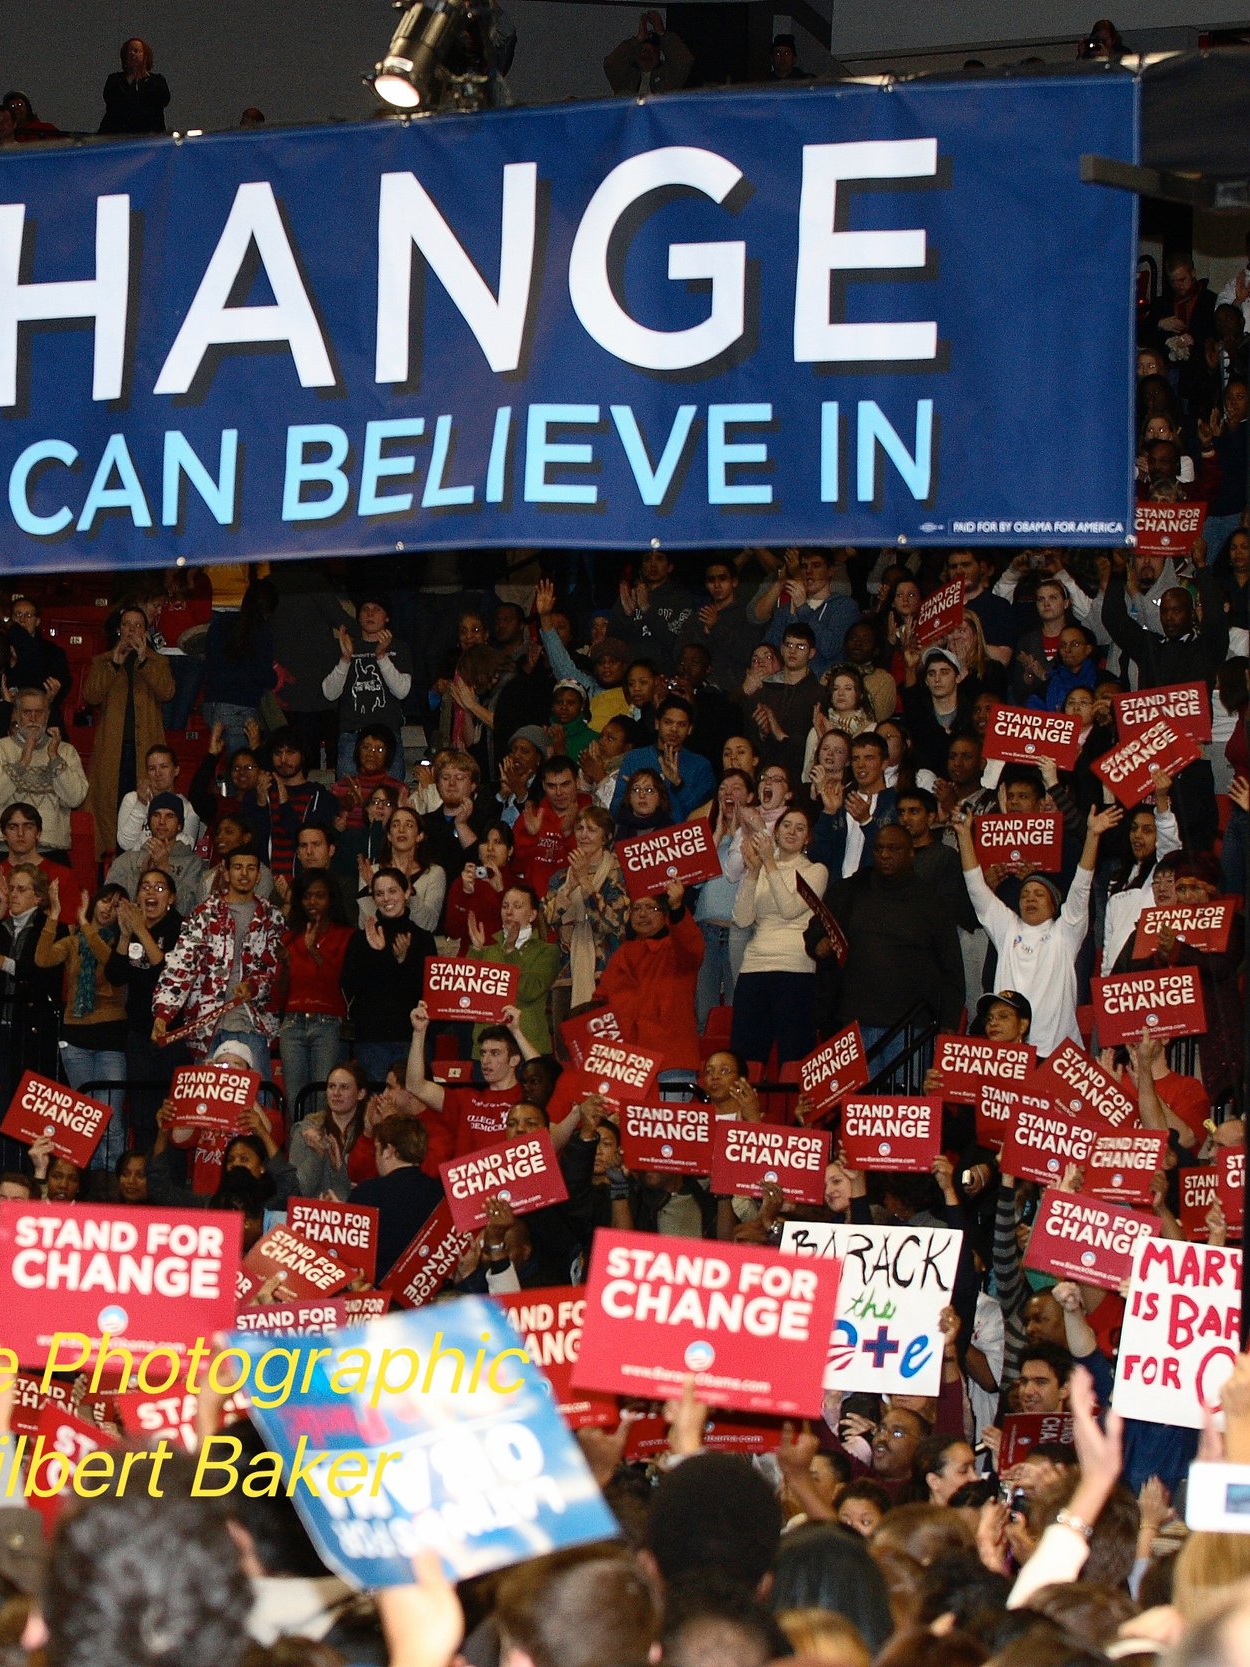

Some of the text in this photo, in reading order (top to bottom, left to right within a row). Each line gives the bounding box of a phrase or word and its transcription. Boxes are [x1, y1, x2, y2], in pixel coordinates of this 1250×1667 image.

[9, 429, 237, 535] CAN
[282, 403, 773, 522] BELIEVE
[820, 400, 934, 503] IN
[1134, 518, 1199, 532] CHANGE
[1136, 507, 1201, 519] STAND FOR
[953, 521, 1124, 533] PAID FOR BY OBAMA FOR AMERICA
[918, 590, 961, 626] CHANGE
[920, 581, 962, 614] STAND FOR
[1120, 689, 1199, 711] STAND FOR
[1121, 701, 1201, 726] CHANGE
[994, 721, 1073, 745] CHANGE
[996, 711, 1074, 732] STAND FOR
[1100, 739, 1141, 775] STAND
[1139, 720, 1169, 743] FOR
[1108, 728, 1178, 783] CHANGE
[980, 831, 1054, 847] CHANGE
[981, 819, 1055, 832] STAND FOR
[623, 825, 703, 858] STAND FOR
[627, 837, 707, 872] CHANGE
[1143, 916, 1223, 934] CHANGE
[1145, 906, 1225, 922] STAND FOR
[430, 963, 511, 982] STAND FOR
[1102, 974, 1193, 998] STAND FOR
[429, 976, 509, 997] CHANGE
[1104, 988, 1196, 1015] CHANGE
[602, 1012, 624, 1043] STA
[590, 1043, 655, 1072] STAND FOR
[801, 1030, 856, 1078] STAND FOR
[943, 1042, 1029, 1064] STAND FOR
[177, 1072, 251, 1089] STAND FOR
[584, 1056, 649, 1088] CHANGE
[802, 1042, 859, 1092] CHANGE
[941, 1056, 1027, 1080] CHANGE
[174, 1084, 248, 1105] CHANGE
[981, 1085, 1019, 1104] STAND
[1052, 1057, 1126, 1127] CHANGE
[1062, 1047, 1105, 1088] STAND
[1104, 1086, 1134, 1115] FOR
[21, 1093, 99, 1138] CHANGE
[27, 1080, 103, 1124] STAND FOR
[626, 1105, 709, 1125] STAND FOR
[846, 1103, 931, 1120] STAND FOR
[981, 1100, 1011, 1121] CHA
[626, 1119, 709, 1142] CHANGE
[727, 1129, 823, 1153] STAND FOR
[845, 1118, 930, 1139] CHANGE
[1017, 1112, 1096, 1144] STAND FO
[725, 1144, 821, 1171] CHANGE
[1014, 1127, 1091, 1161] CHANG
[1095, 1136, 1161, 1152] STAND FOR
[448, 1139, 542, 1183] STAND FOR
[1091, 1150, 1158, 1171] CHANGE
[451, 1153, 547, 1200] CHANGE
[1184, 1174, 1219, 1189] STAN
[1184, 1189, 1217, 1207] CHA
[292, 1205, 371, 1229] STAND FOR
[1050, 1200, 1153, 1239] STAND FOR
[15, 1215, 225, 1258] STAND FOR
[292, 1221, 370, 1249] CHANGE
[260, 1241, 334, 1290] CHANGE
[270, 1230, 346, 1281] STAND FOR
[403, 1224, 459, 1303] HANGE
[413, 1231, 472, 1306] STAND FOR
[791, 1229, 953, 1293] BARACK
[11, 1247, 222, 1299] CHANGE
[235, 1271, 253, 1294] OR
[606, 1246, 819, 1301] STAND FOR
[236, 1306, 337, 1330] STAND FOR
[361, 1299, 384, 1313] FOR
[508, 1299, 587, 1332] AND FO
[600, 1279, 815, 1342] CHANGE
[846, 1288, 897, 1321] the
[1131, 1291, 1159, 1321] IS
[524, 1330, 583, 1367] ANG
[1123, 1355, 1181, 1389] FOR
[14, 1379, 66, 1400] TAND
[137, 1394, 198, 1430] STA
[1039, 1417, 1061, 1444] CHA
